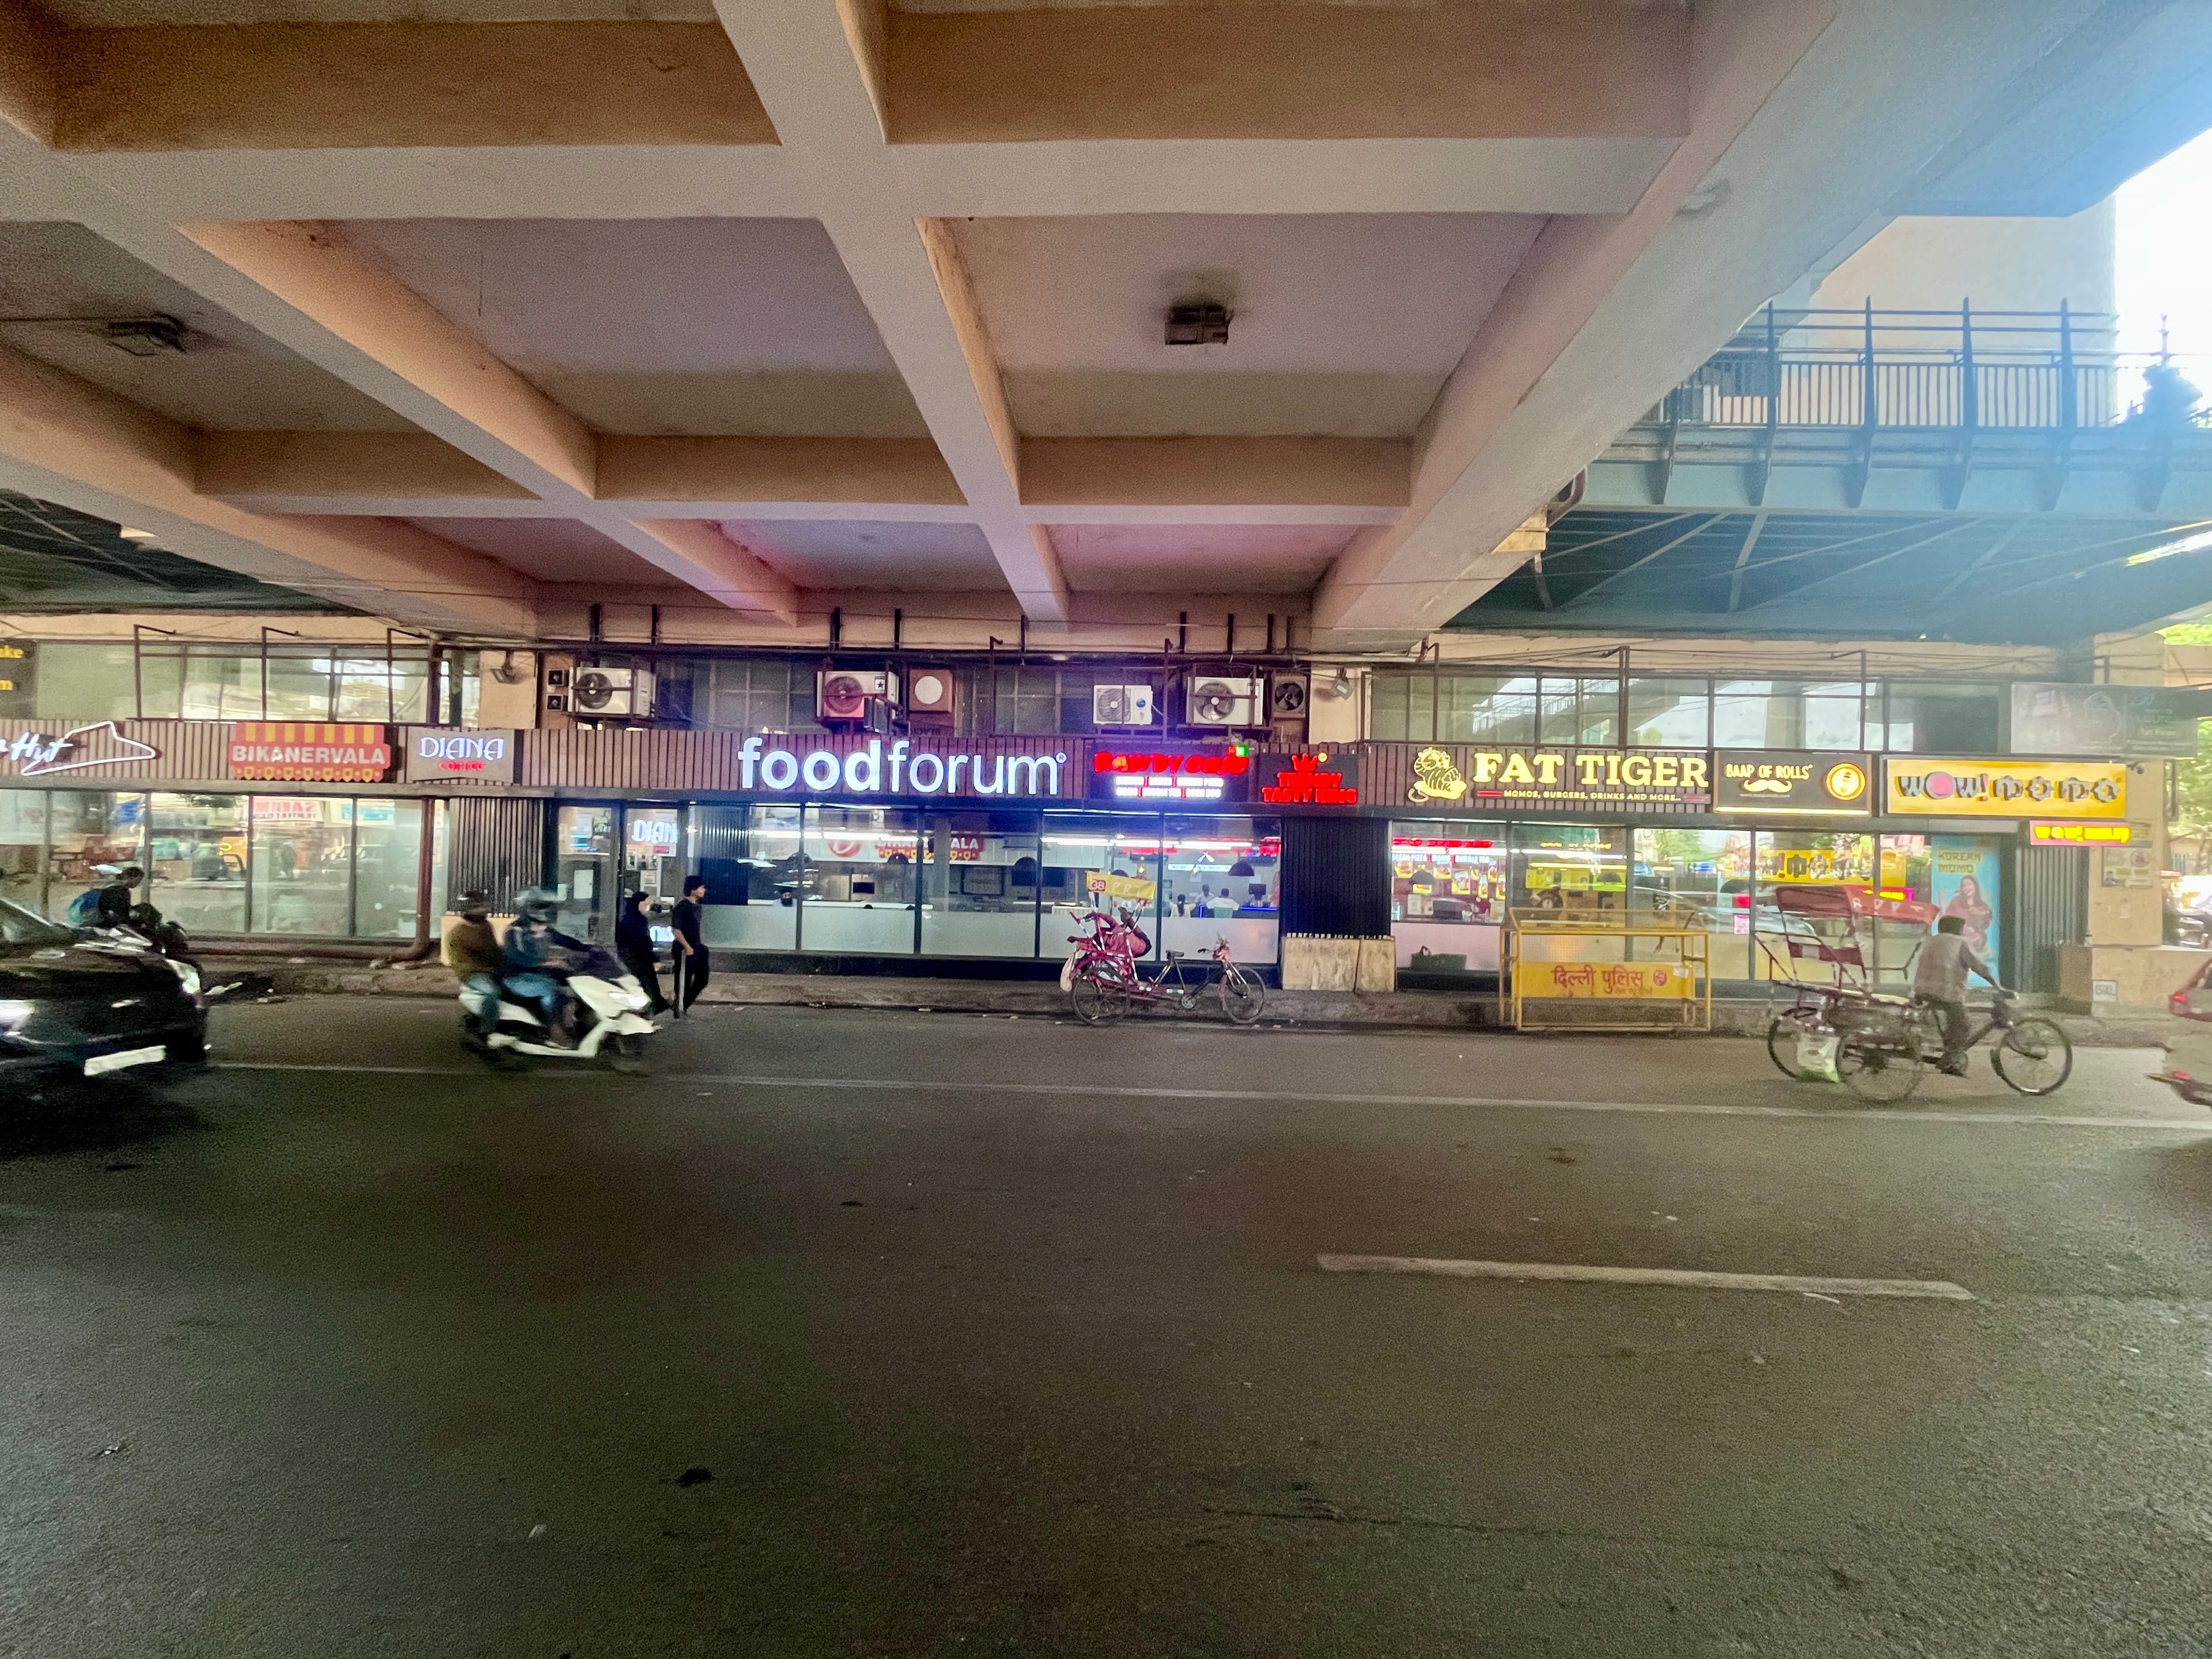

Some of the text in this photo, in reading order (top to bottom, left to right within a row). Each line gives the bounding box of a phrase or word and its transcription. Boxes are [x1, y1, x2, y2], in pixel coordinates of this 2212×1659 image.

[11, 732, 73, 763] Hut
[232, 745, 385, 765] BIKANERVALA
[419, 737, 505, 760] DIANA
[1473, 752, 1710, 788] FAT TIGER
[1725, 763, 1755, 778] BAAP
[1758, 764, 1773, 778] OF
[1262, 787, 1313, 802] TASTY
[1503, 790, 1541, 800] MOMOS,
[1543, 791, 1588, 800] BURGERS,
[1590, 792, 1625, 801] DRINKS
[1938, 851, 1981, 861] KOREAN
[1938, 864, 1974, 873] MOMO
[1092, 880, 1105, 891] 38
[1551, 964, 1645, 994] दिल्ली पुलिस
